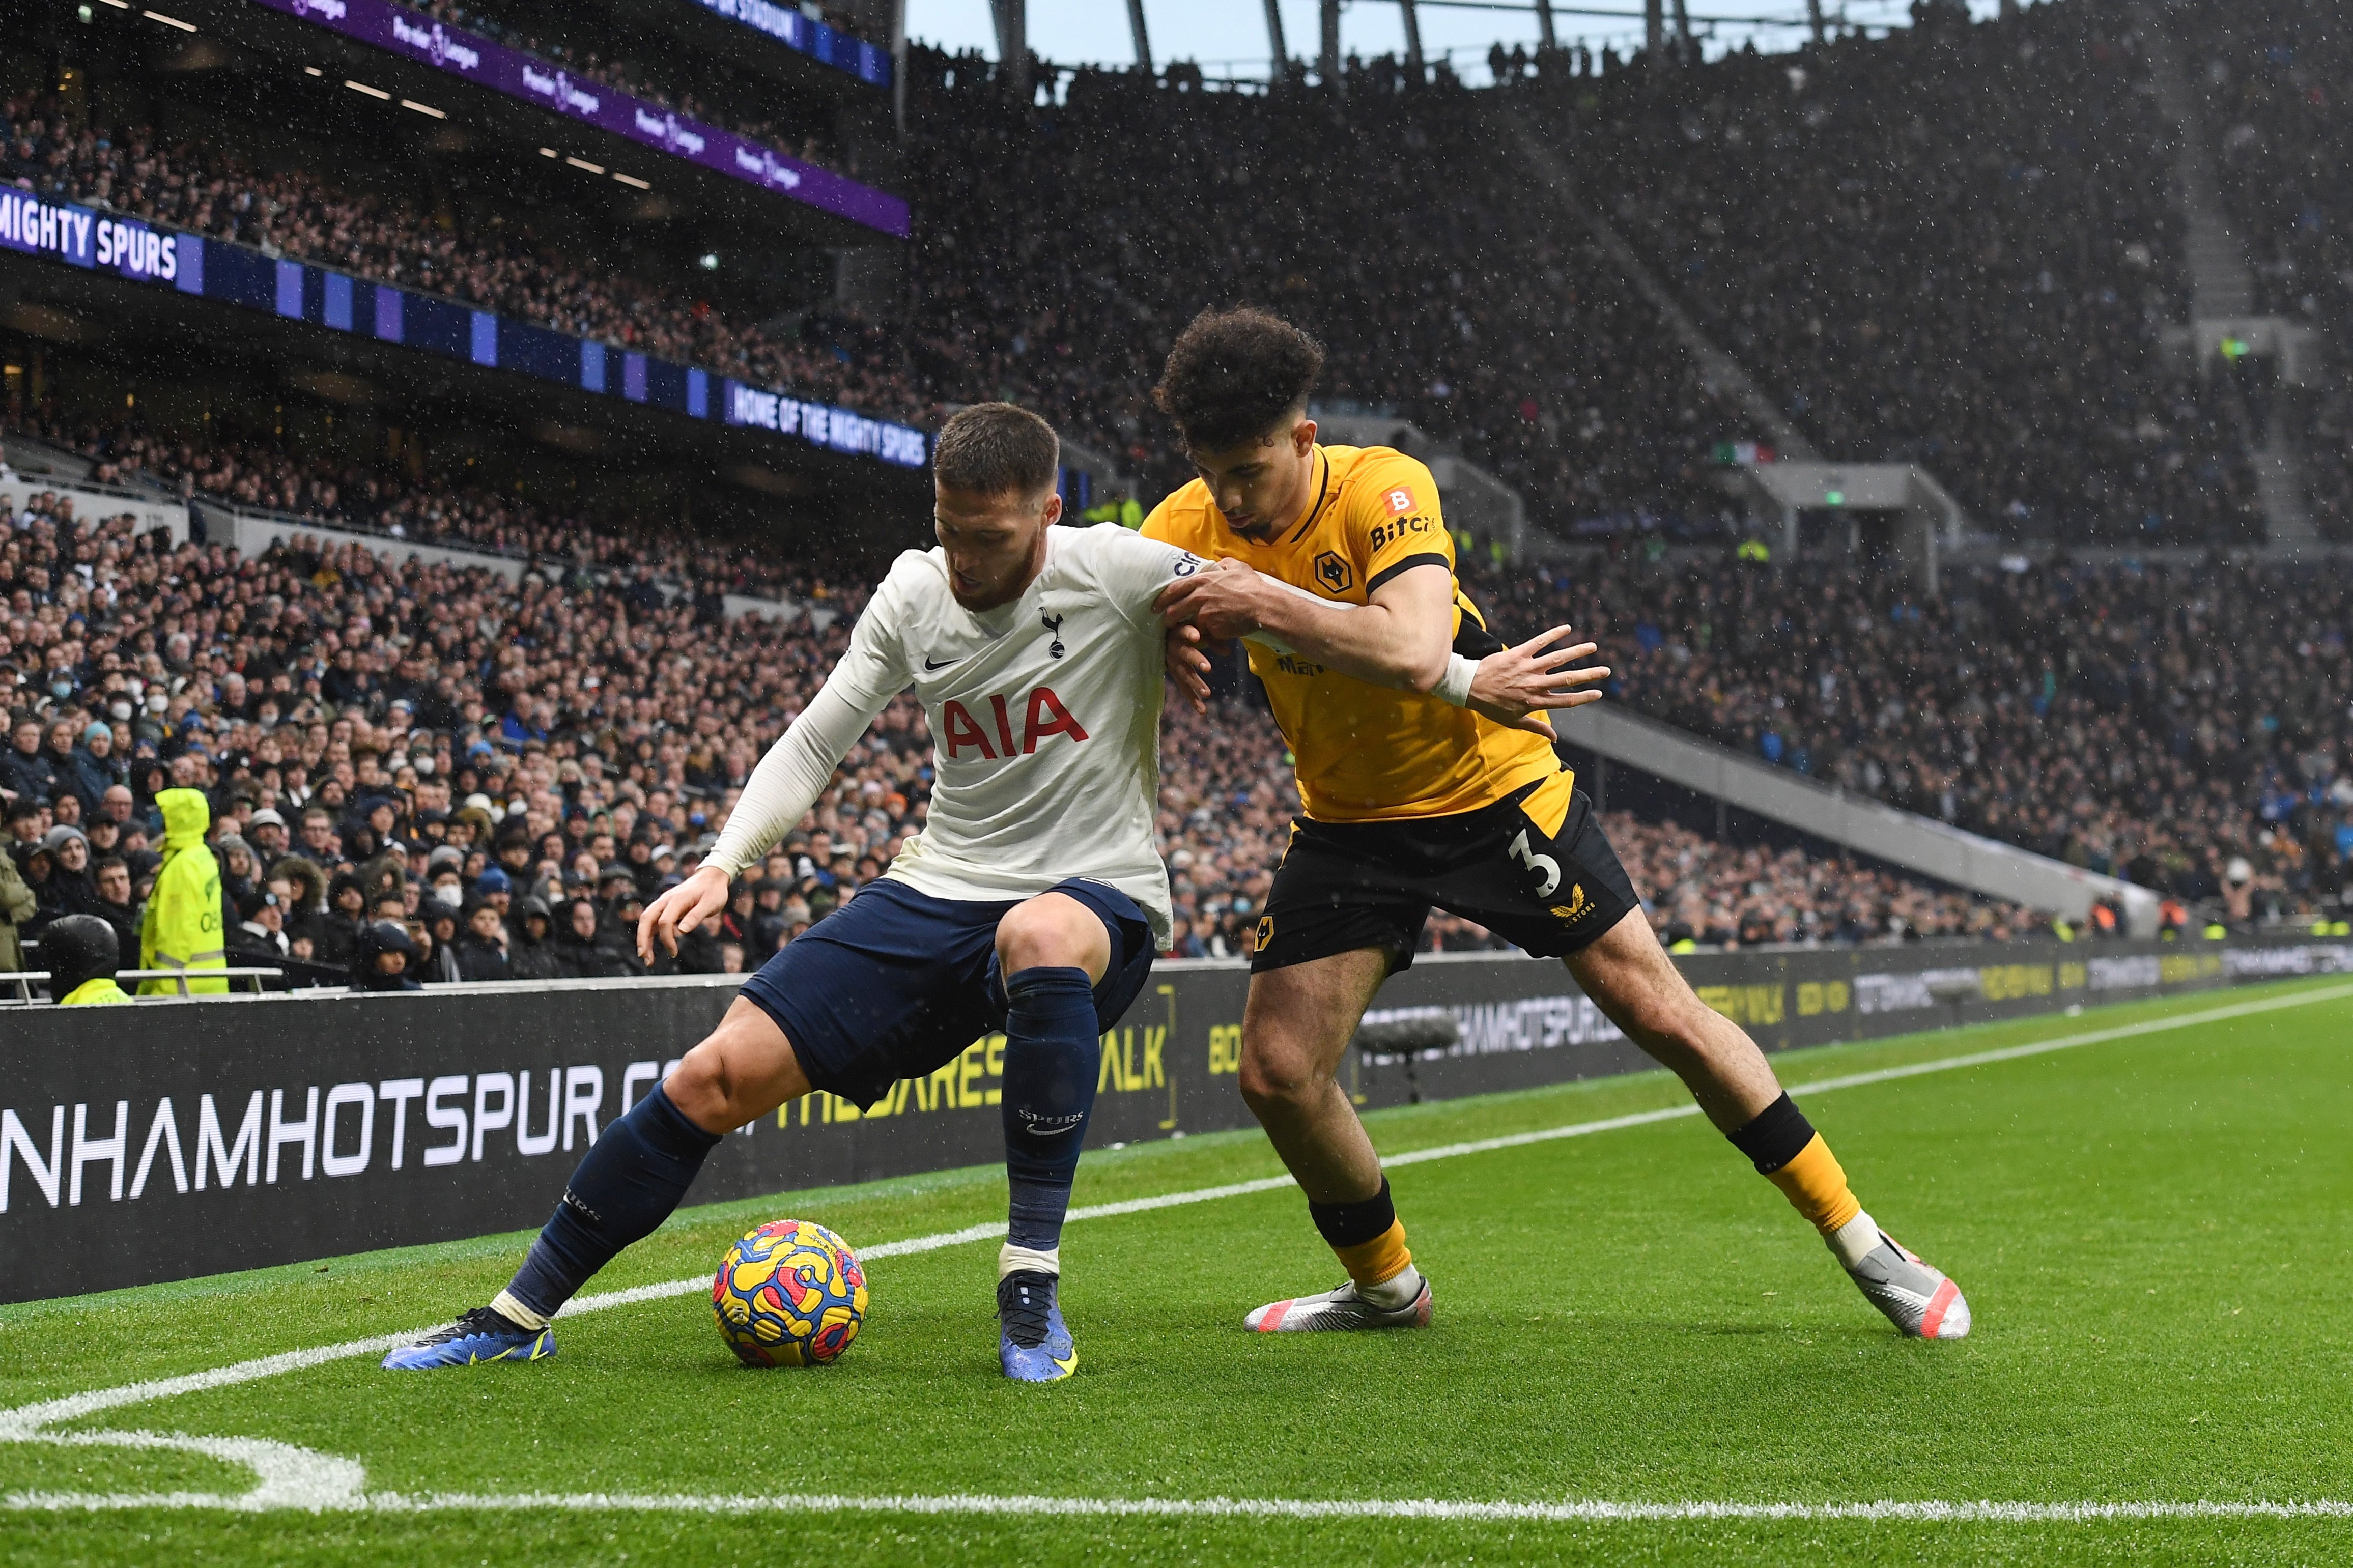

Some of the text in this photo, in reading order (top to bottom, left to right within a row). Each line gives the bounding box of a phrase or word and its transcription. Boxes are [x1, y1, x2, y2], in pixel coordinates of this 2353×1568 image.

[97, 219, 177, 280] SPURS
[943, 687, 1089, 760] AIA
[1508, 828, 1561, 898] 3
[1564, 901, 1596, 928] CASTORE
[1019, 1109, 1084, 1125] SPURS
